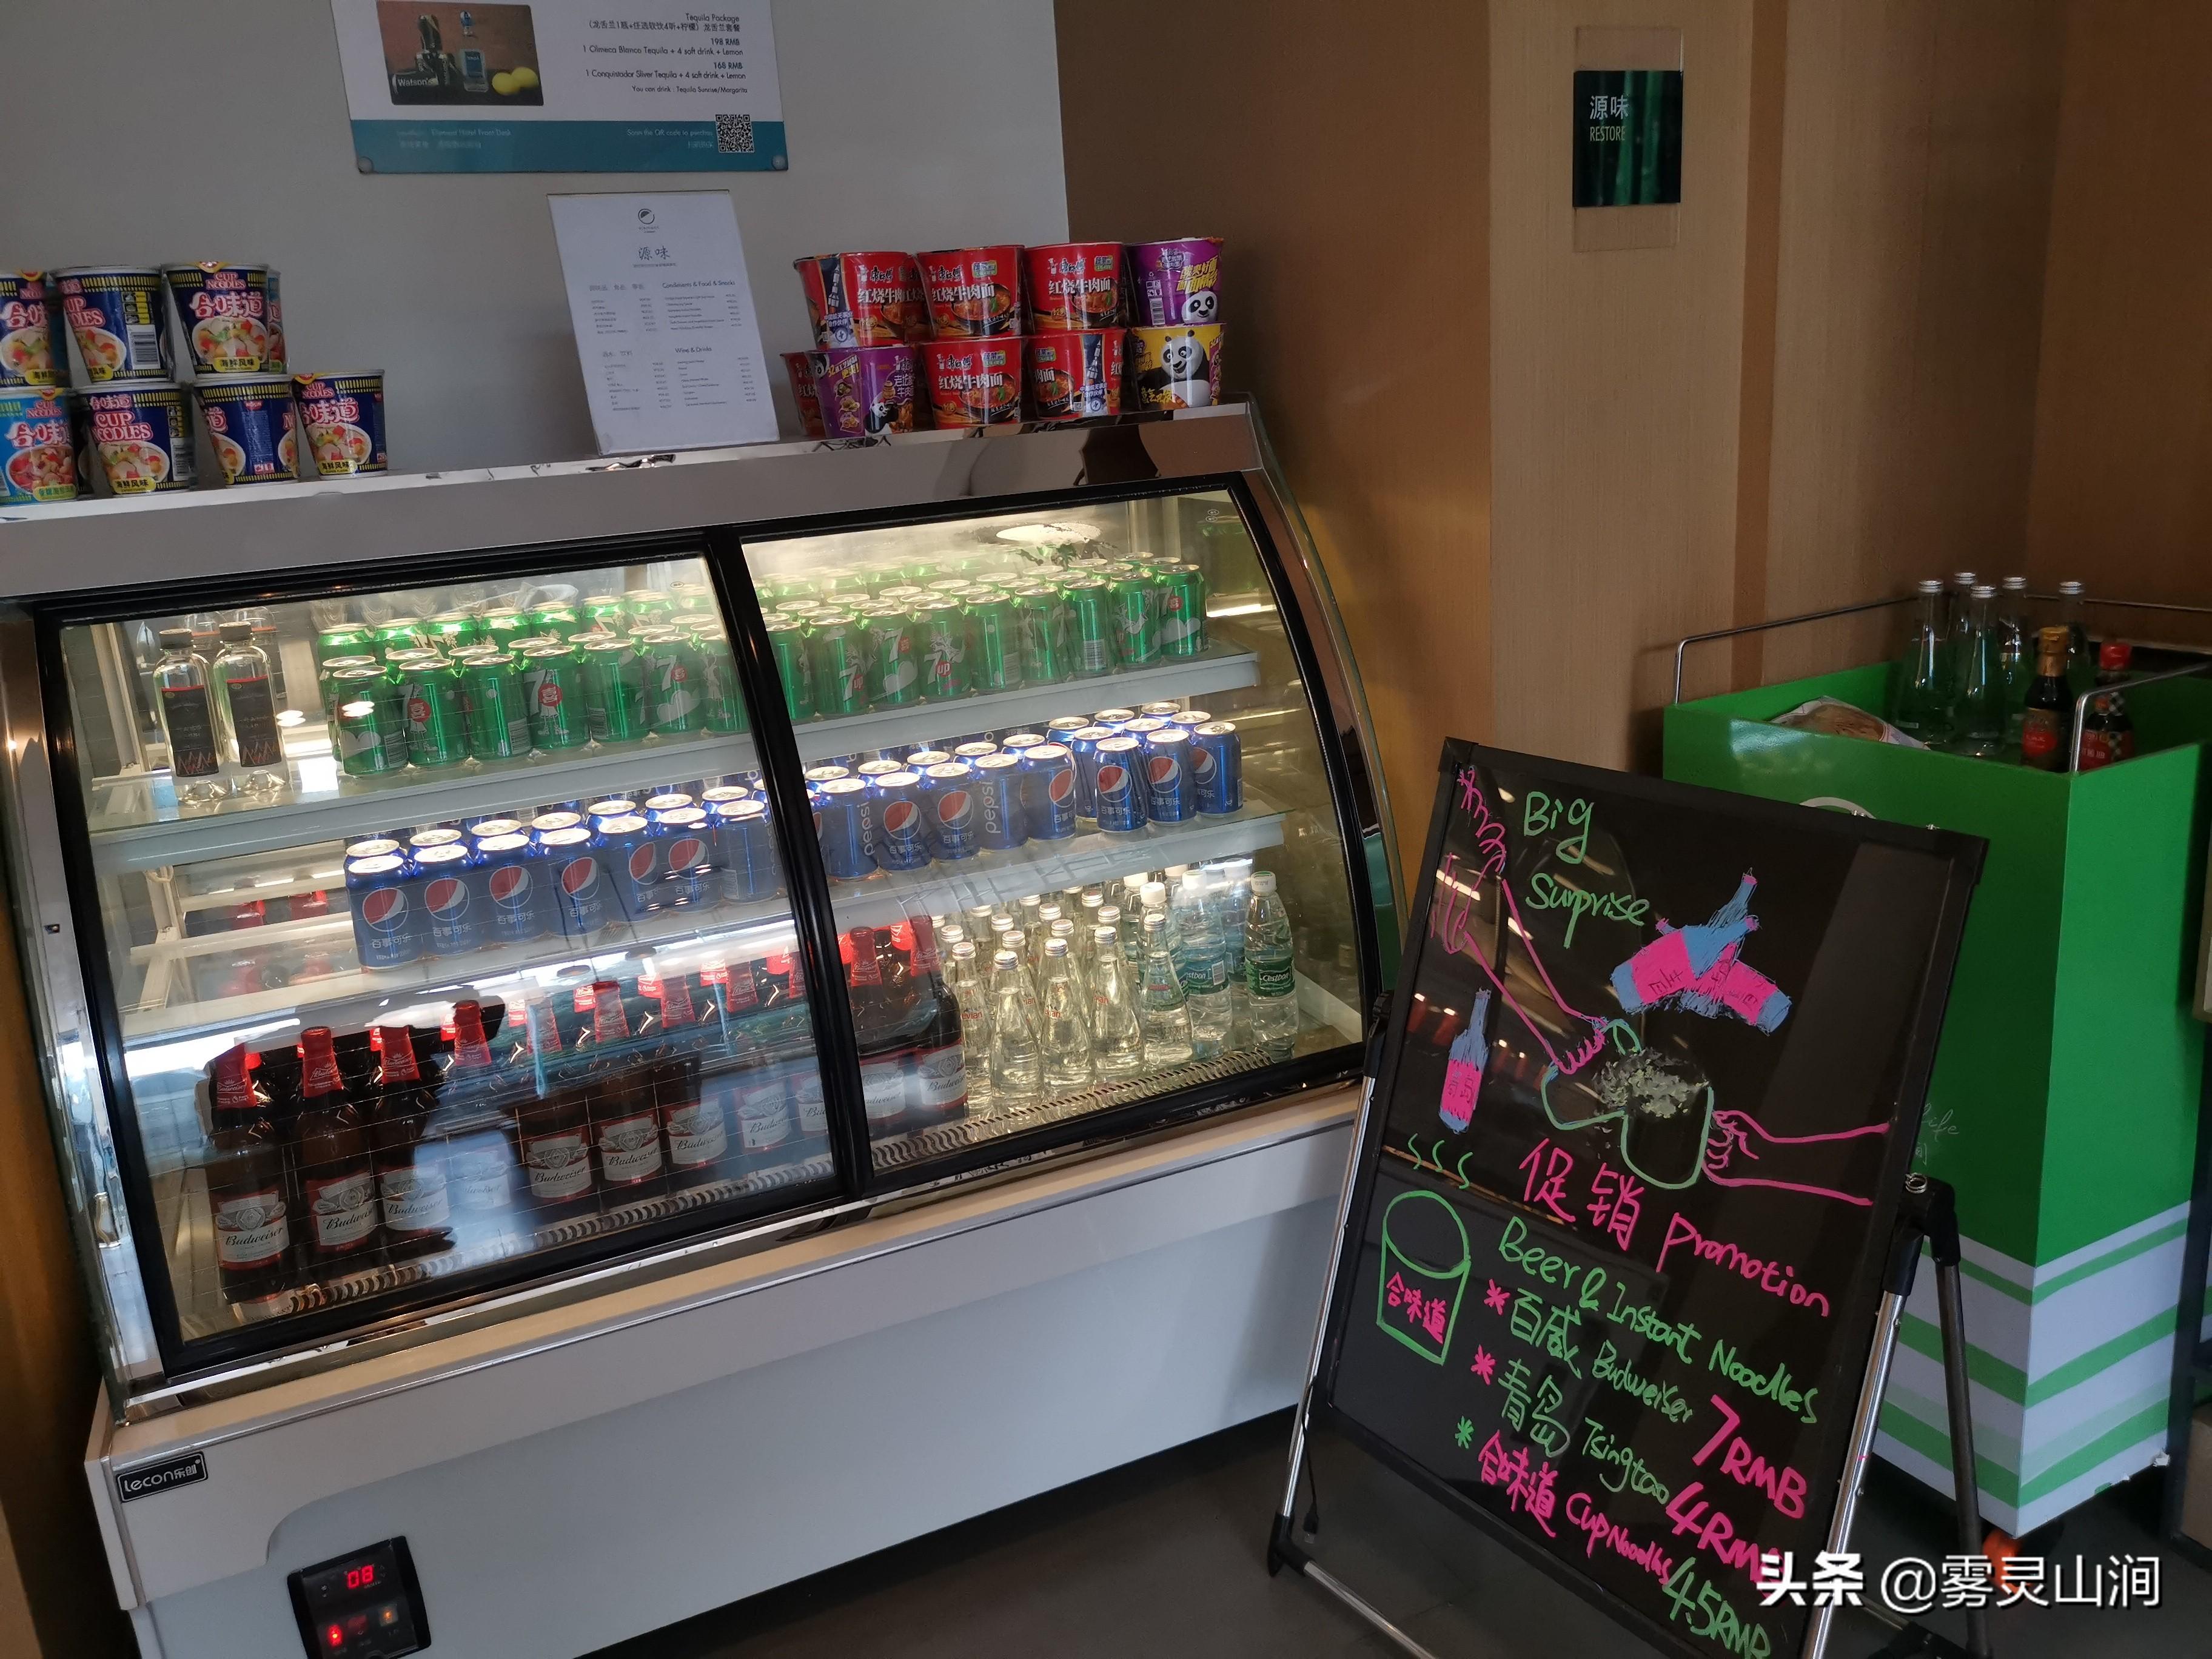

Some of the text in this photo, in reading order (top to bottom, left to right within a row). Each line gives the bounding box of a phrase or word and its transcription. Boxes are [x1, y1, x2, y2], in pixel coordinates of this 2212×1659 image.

[686, 13, 740, 23] Tequila Package
[618, 45, 642, 54] Blanco
[643, 46, 668, 56] Tequila
[684, 47, 696, 55] soft
[654, 70, 677, 81] Tequila
[676, 86, 697, 95] Tequila
[1589, 94, 1629, 121] 源味
[1589, 126, 1626, 142] RESTORE
[638, 246, 670, 261] 源味
[206, 280, 246, 290] NOODLES
[215, 272, 238, 281] CUP
[931, 283, 995, 303] 红烧牛肉面
[1048, 276, 1111, 295] 红烧牛肉面
[857, 287, 903, 304] 红烧牛肉
[189, 291, 263, 318] 合味道
[938, 371, 1004, 390] 红烧牛肉面
[95, 411, 134, 427] CUP
[982, 779, 1001, 834] pepsi
[1150, 796, 1181, 806] 百事可乐
[1100, 805, 1131, 816] 百事可乐
[856, 801, 876, 857] pepsi
[1524, 791, 1595, 864] Big
[889, 842, 922, 855] 百事可乐
[674, 882, 711, 895] 百事可乐
[497, 910, 535, 925] 百事可乐
[1524, 873, 1651, 950] Surprise
[432, 922, 472, 937] 百事可乐
[371, 932, 412, 949] 百事可乐
[960, 1010, 983, 1020] evian
[608, 1148, 658, 1166] Budweiser
[535, 1165, 586, 1183] Budweiser
[386, 1198, 443, 1215] Budweiser
[1518, 1138, 1830, 1318] 促销 Promotion
[226, 1227, 284, 1247] Budweiser
[1385, 1271, 1447, 1344] 合味道
[1498, 1216, 1819, 1424] Beer & Instant Noodles
[1509, 1287, 1584, 1380] 百威
[1497, 1358, 1571, 1458] 青岛
[1582, 1416, 1671, 1505] Tsingtao
[1478, 1429, 1559, 1538] 合味道
